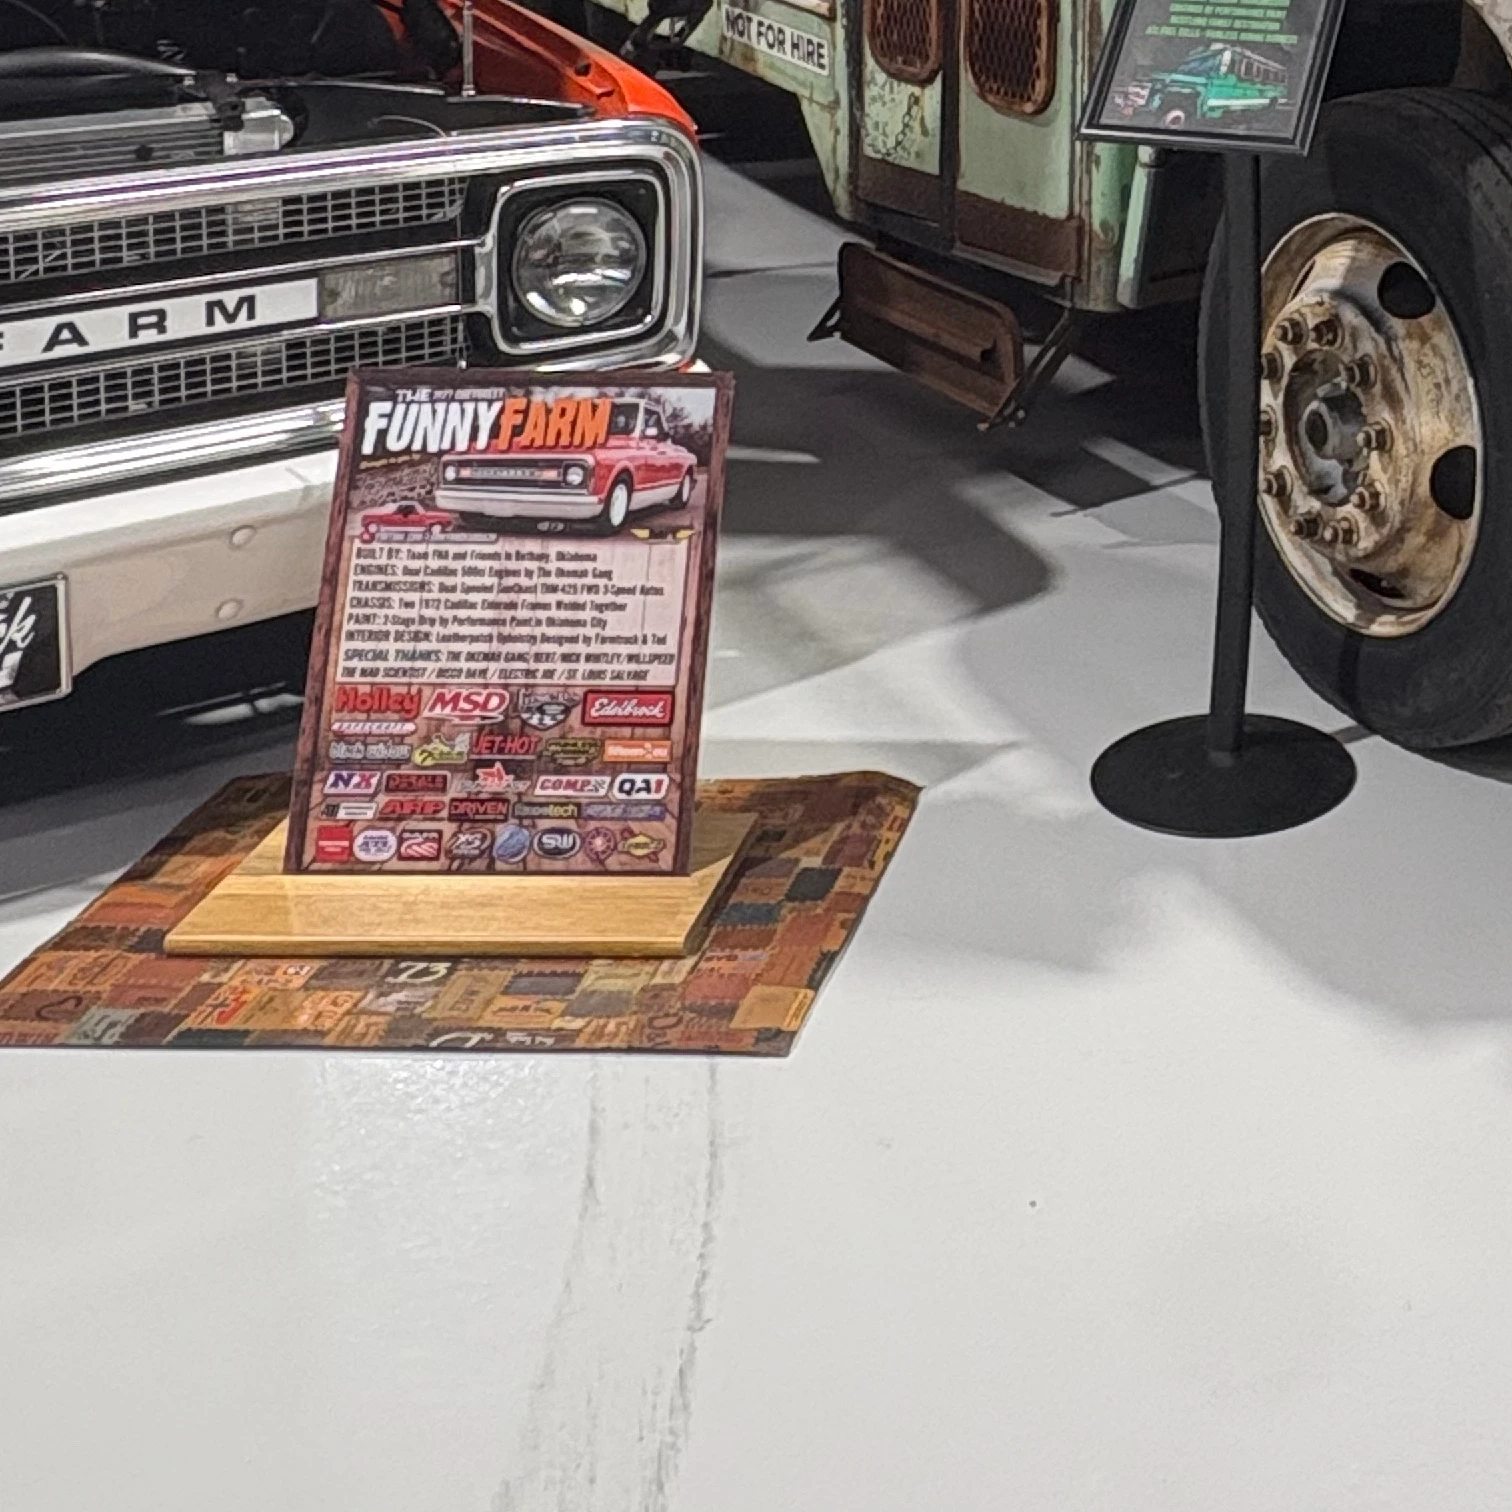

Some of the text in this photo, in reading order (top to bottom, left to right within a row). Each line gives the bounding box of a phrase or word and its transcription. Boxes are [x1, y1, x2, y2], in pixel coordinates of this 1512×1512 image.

[724, 11, 828, 72] NOT FOR HIRE
[0, 293, 258, 356] ARM
[395, 388, 432, 402] THE
[555, 550, 598, 562] Oklahoma
[343, 647, 390, 662] SPECIAL
[335, 686, 422, 721] Holley
[429, 689, 510, 715] MSD
[330, 771, 377, 789] NX
[617, 777, 666, 796] QA1
[450, 799, 508, 817] DRIVEN
